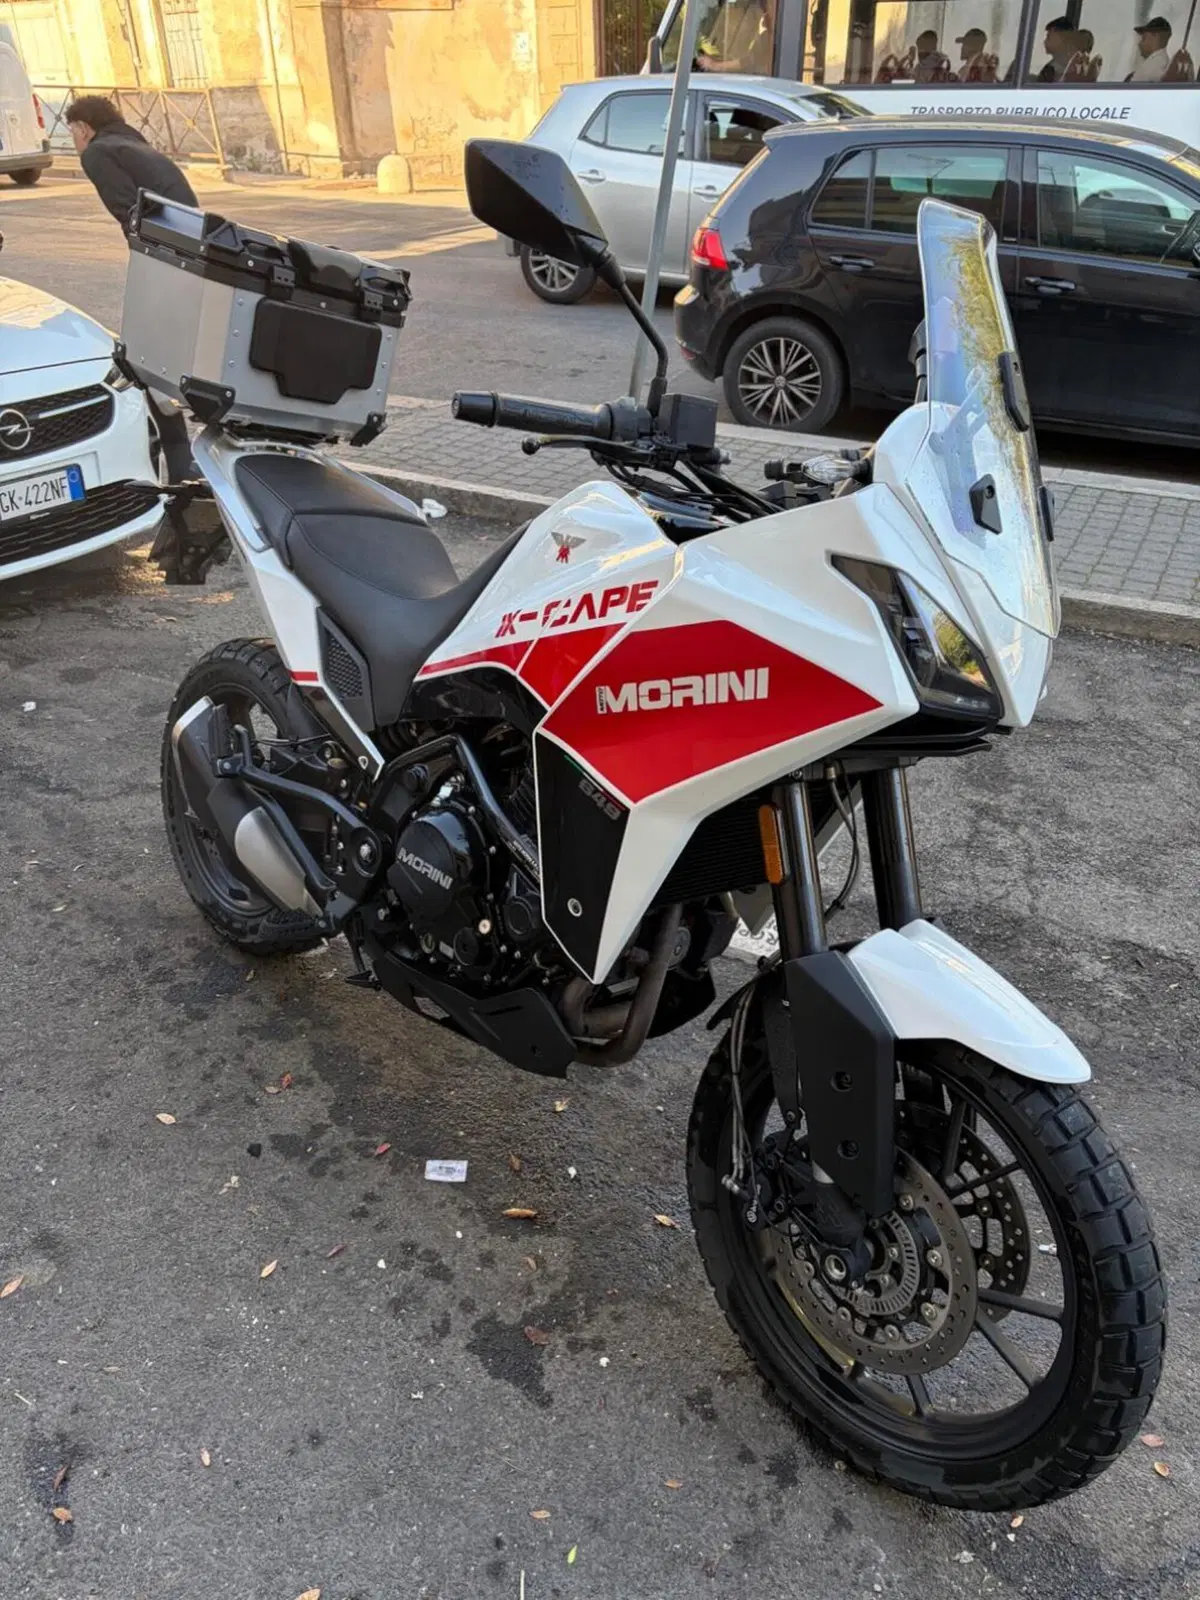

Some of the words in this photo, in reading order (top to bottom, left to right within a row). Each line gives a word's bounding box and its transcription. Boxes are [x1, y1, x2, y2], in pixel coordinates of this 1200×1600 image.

[1070, 107, 1132, 120] LOCALE
[605, 667, 770, 714] MORINI
[578, 778, 621, 821] 649
[397, 847, 454, 891] MORINI
